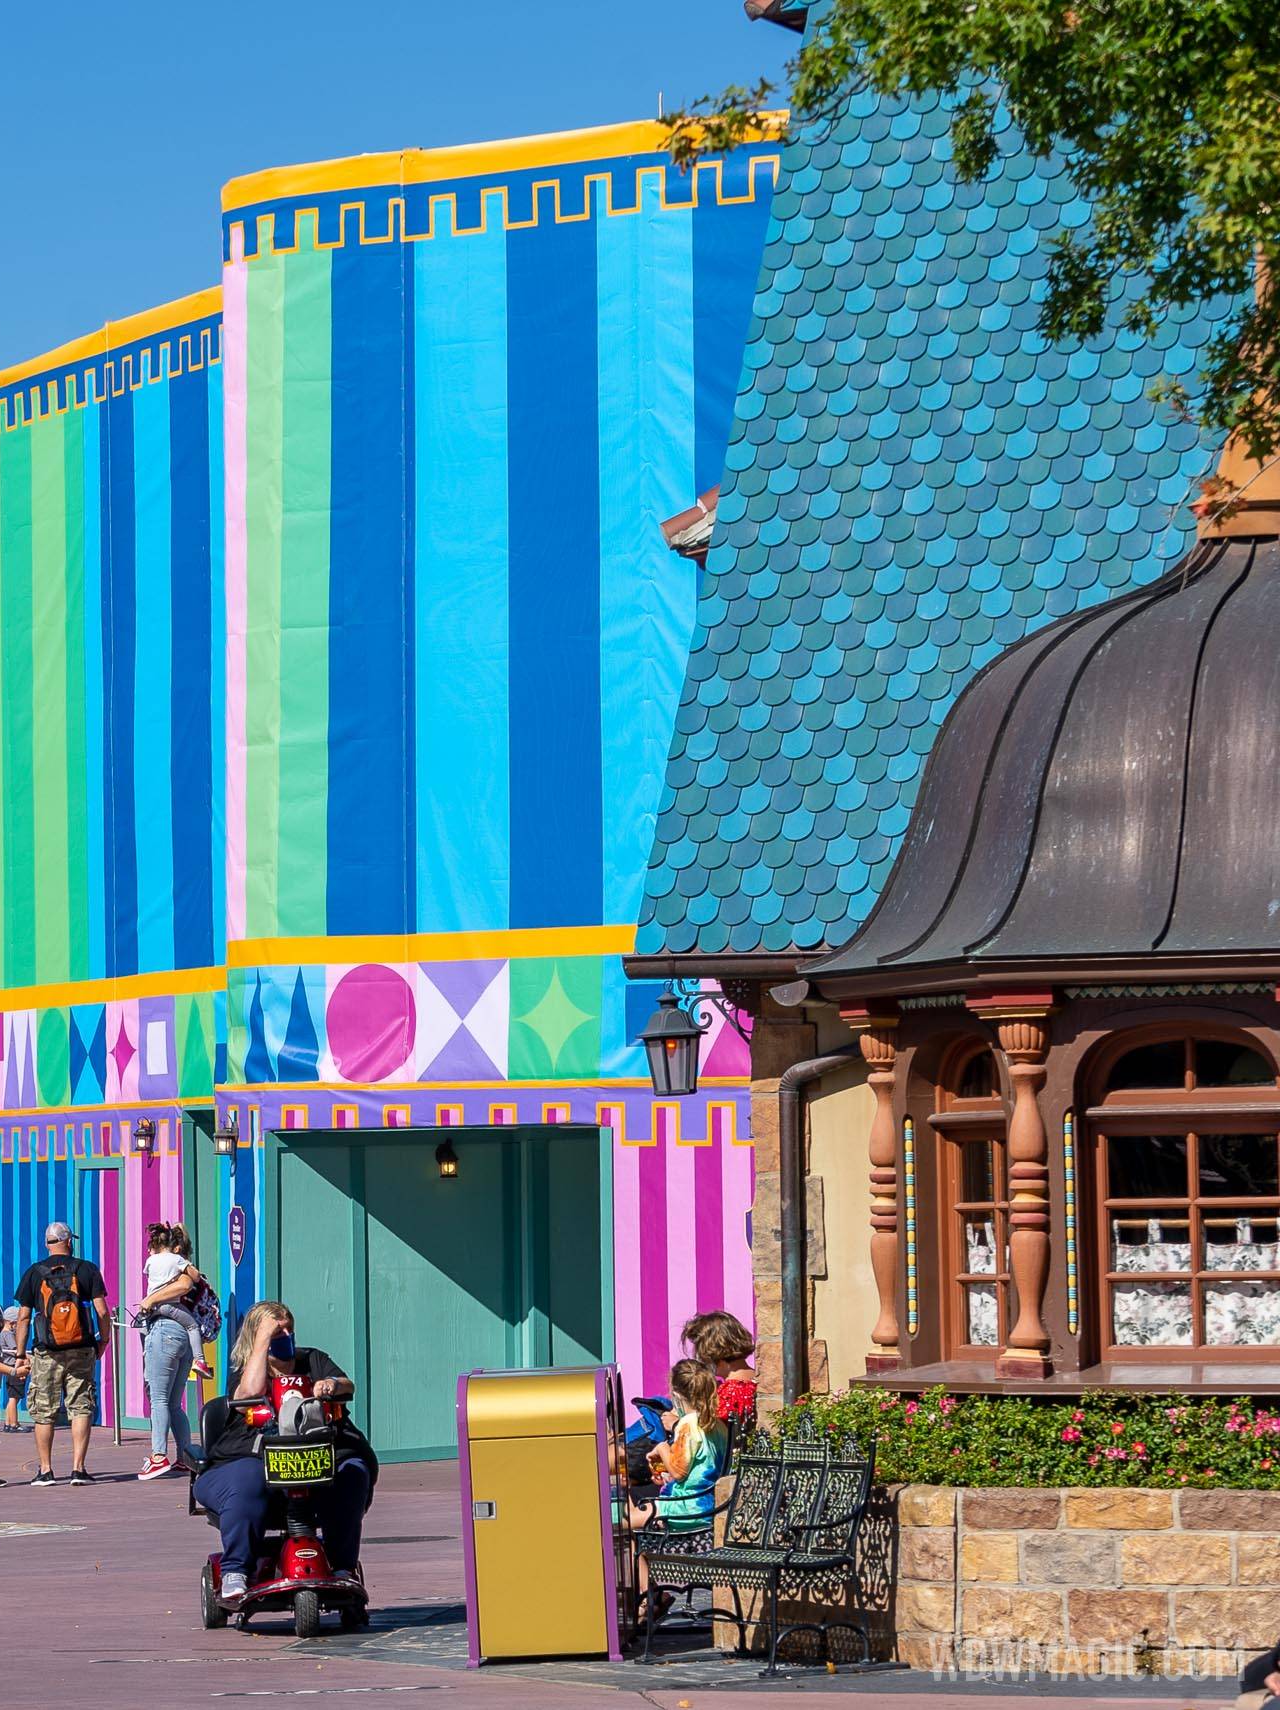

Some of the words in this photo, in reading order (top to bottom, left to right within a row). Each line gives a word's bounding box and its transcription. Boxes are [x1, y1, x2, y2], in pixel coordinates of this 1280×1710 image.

[280, 1376, 304, 1387] 974
[268, 1451, 301, 1461] BUENA
[303, 1449, 331, 1459] VISTA
[269, 1457, 332, 1473] RENTALS
[279, 1470, 322, 1479] 407-331-9147
